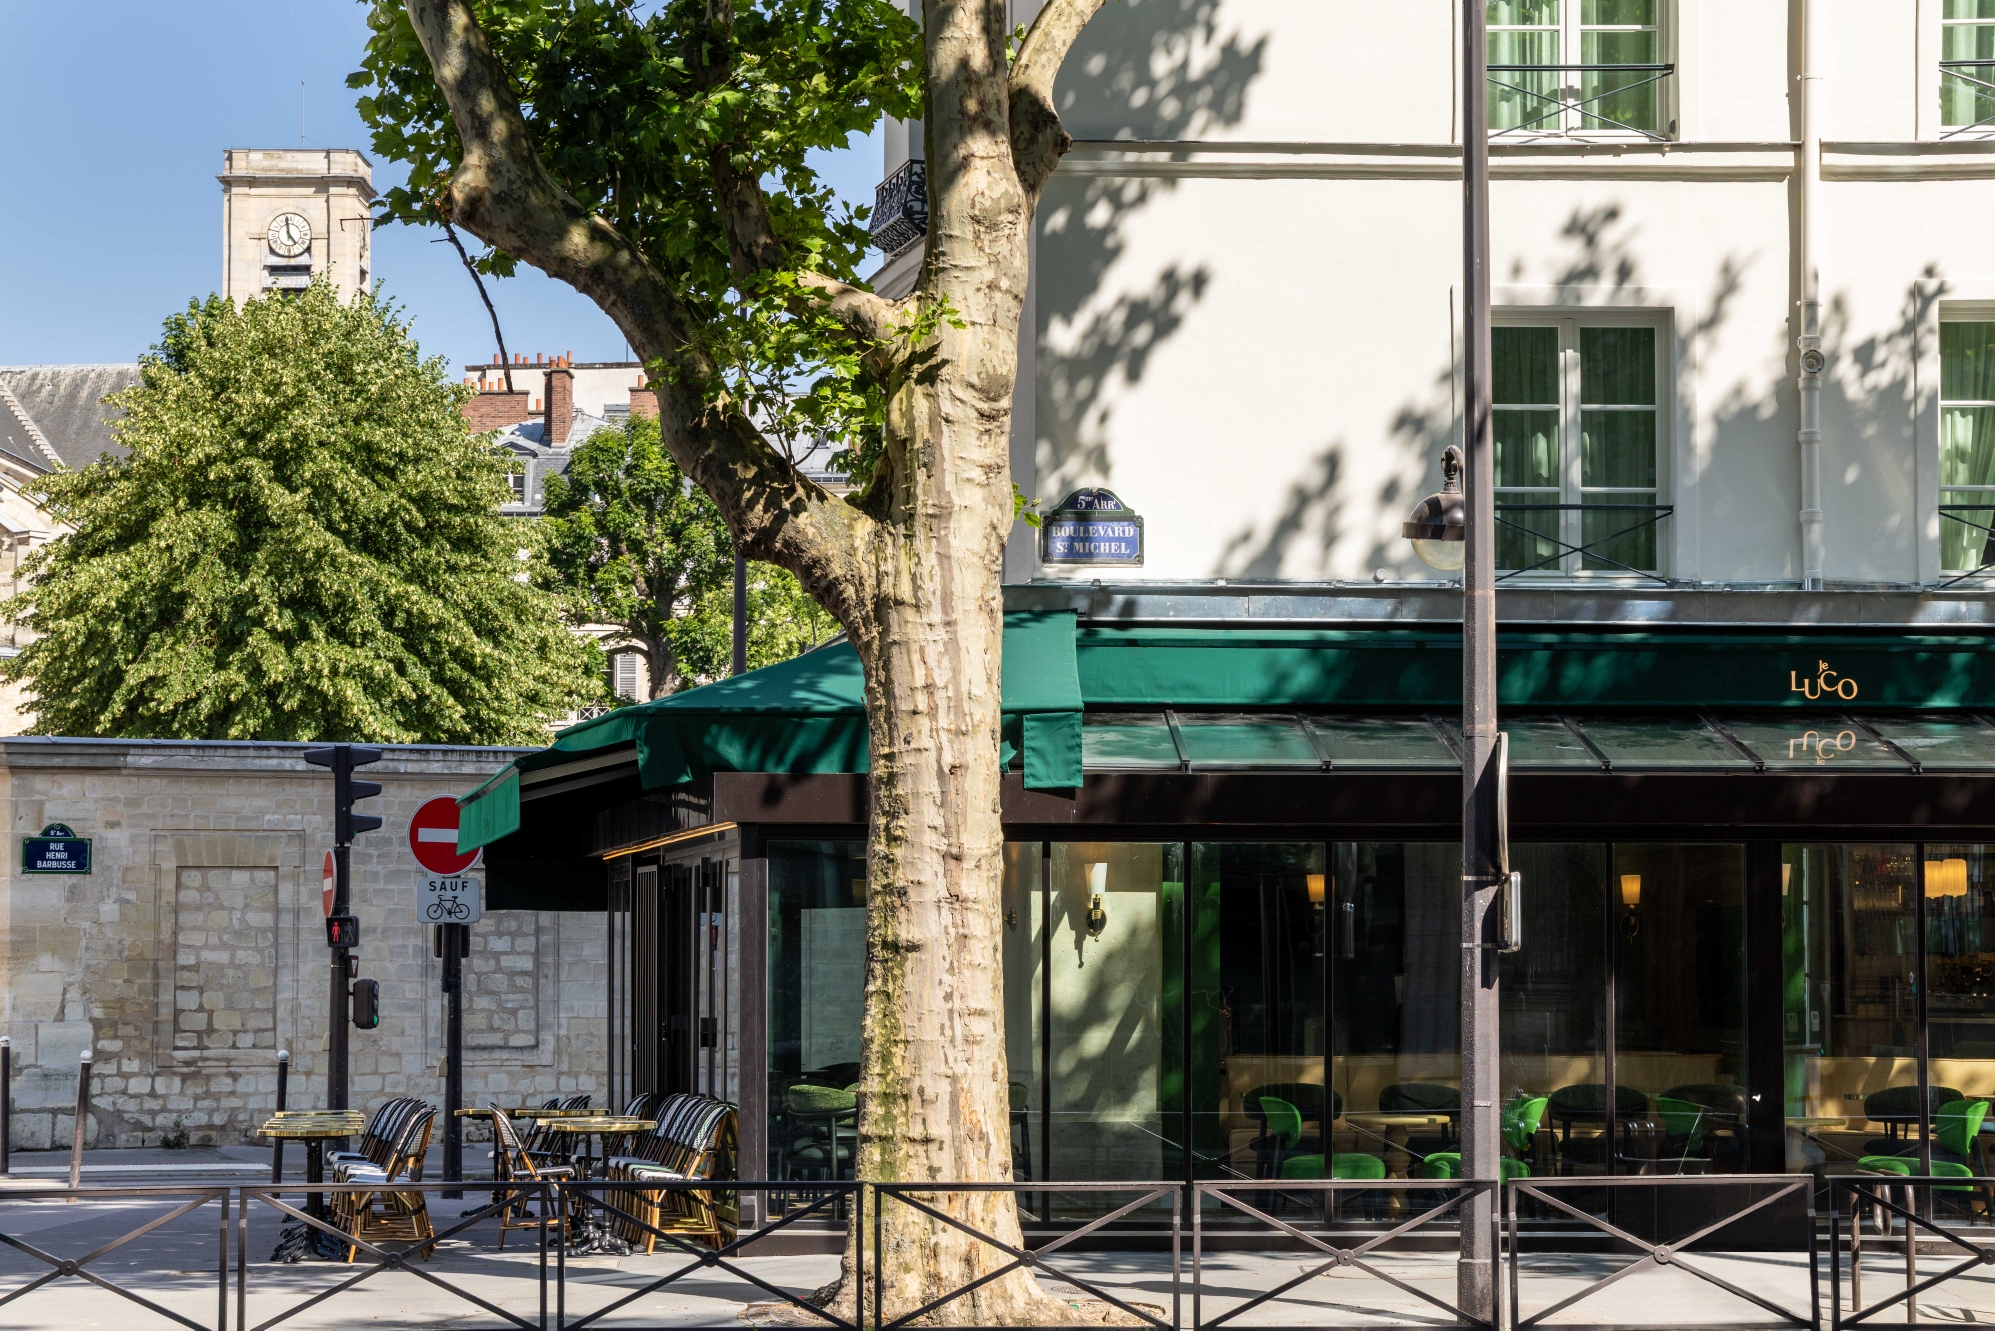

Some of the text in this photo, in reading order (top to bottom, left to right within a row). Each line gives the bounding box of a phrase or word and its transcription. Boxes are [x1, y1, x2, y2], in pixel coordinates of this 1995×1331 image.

[1051, 526, 1135, 538] BOULEVARD
[1073, 541, 1130, 554] MICHEL
[1817, 659, 1829, 675] le
[1790, 670, 1858, 700] LUCO
[49, 842, 65, 851] RUE
[45, 851, 68, 860] HENRI
[36, 860, 77, 869] BARBUSSE
[429, 880, 469, 892] SAUF
